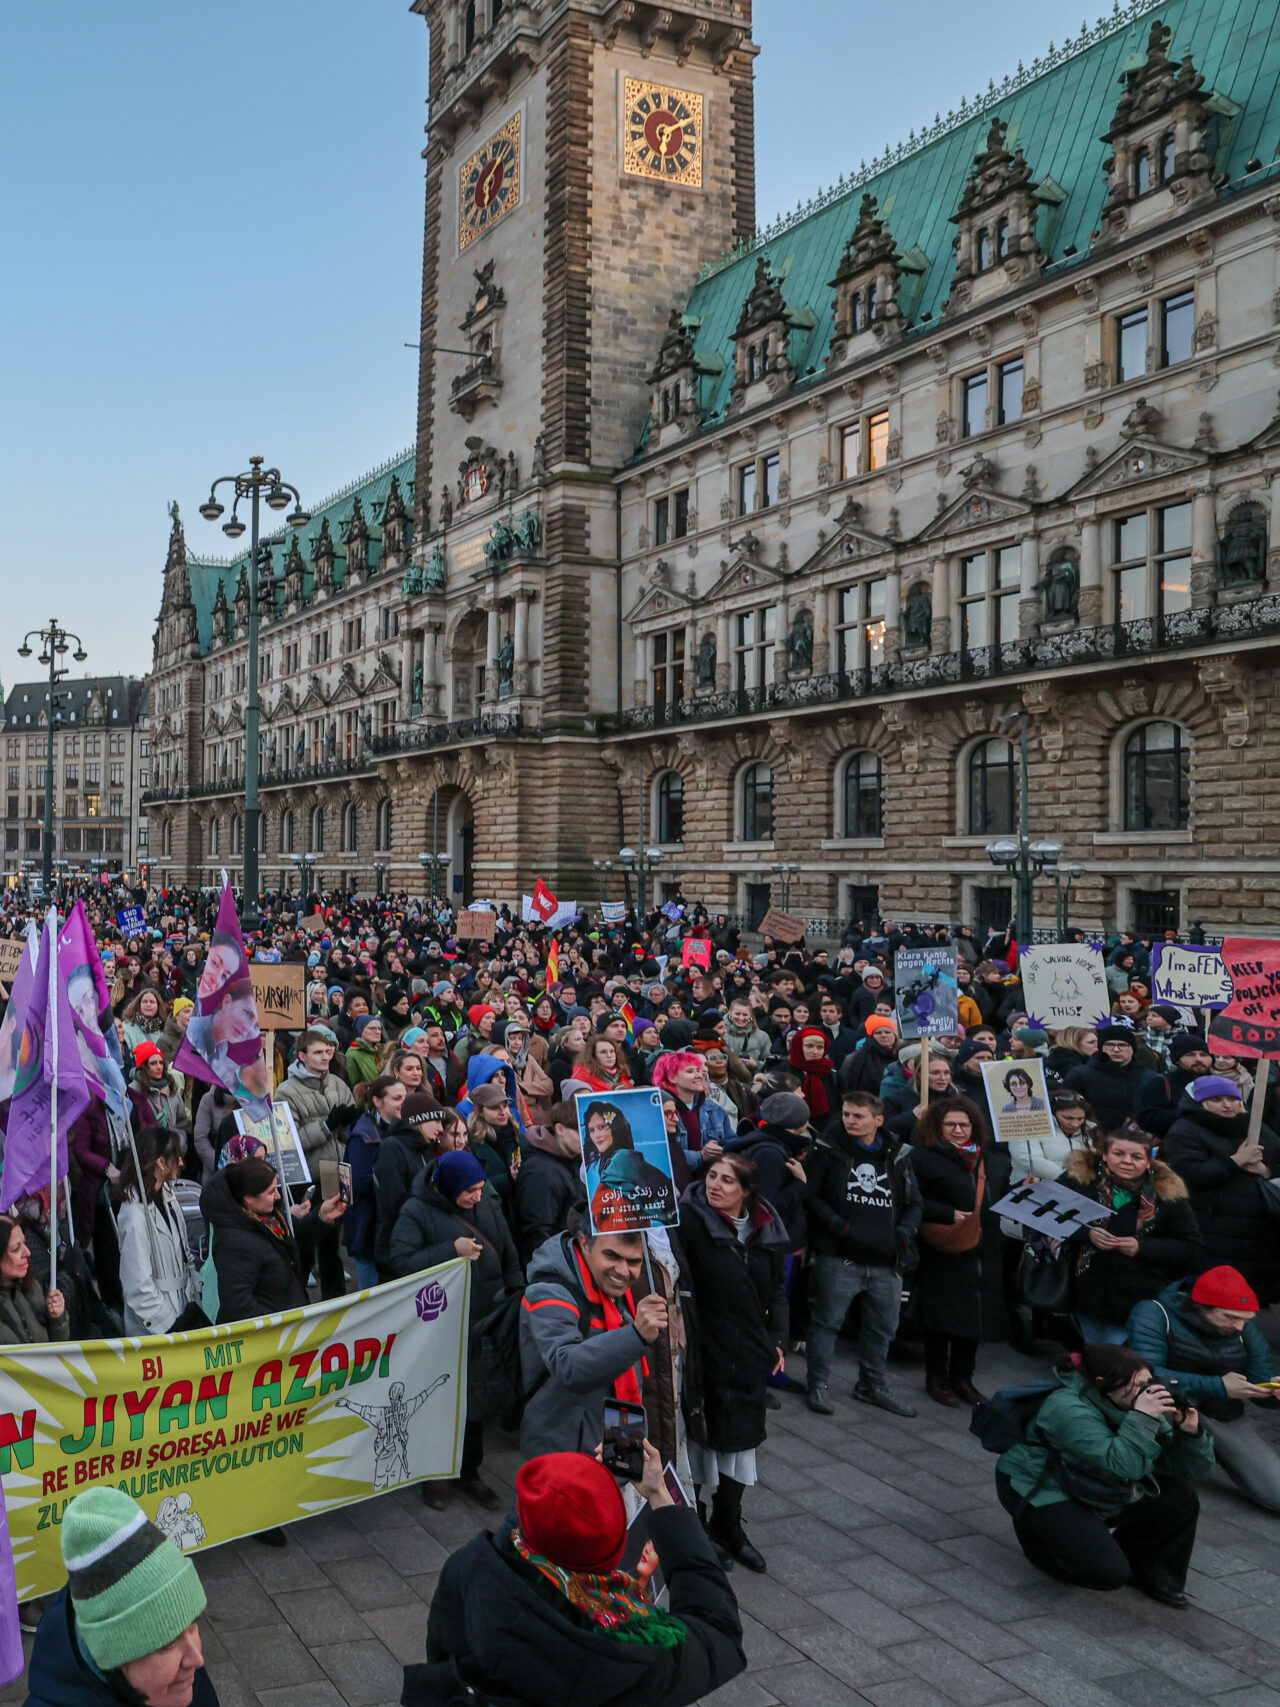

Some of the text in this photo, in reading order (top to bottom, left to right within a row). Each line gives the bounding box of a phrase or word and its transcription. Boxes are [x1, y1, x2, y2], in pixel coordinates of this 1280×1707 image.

[123, 909, 137, 918] END
[897, 951, 948, 960] Klare Kante
[897, 957, 955, 969] gegen Rechts
[1231, 961, 1264, 977] KEEP
[1156, 978, 1196, 1000] What's
[1197, 993, 1221, 1007] your
[1049, 1006, 1083, 1017] THIS!
[1243, 1002, 1264, 1016] OFF
[408, 1110, 444, 1124] SANKT
[628, 1185, 652, 1200] زندگی
[657, 1185, 669, 1197] زن
[203, 1340, 244, 1370] MIT
[142, 1356, 163, 1381] BI
[60, 1371, 234, 1455] JIYAN
[251, 1333, 397, 1412] AZADI
[42, 1465, 68, 1496] RE
[74, 1454, 116, 1485] BER
[121, 1448, 143, 1471] BI
[230, 1412, 272, 1446] JINÊ
[276, 1407, 308, 1431] WE
[37, 1432, 304, 1530] ZU AUENREVOLUTION
